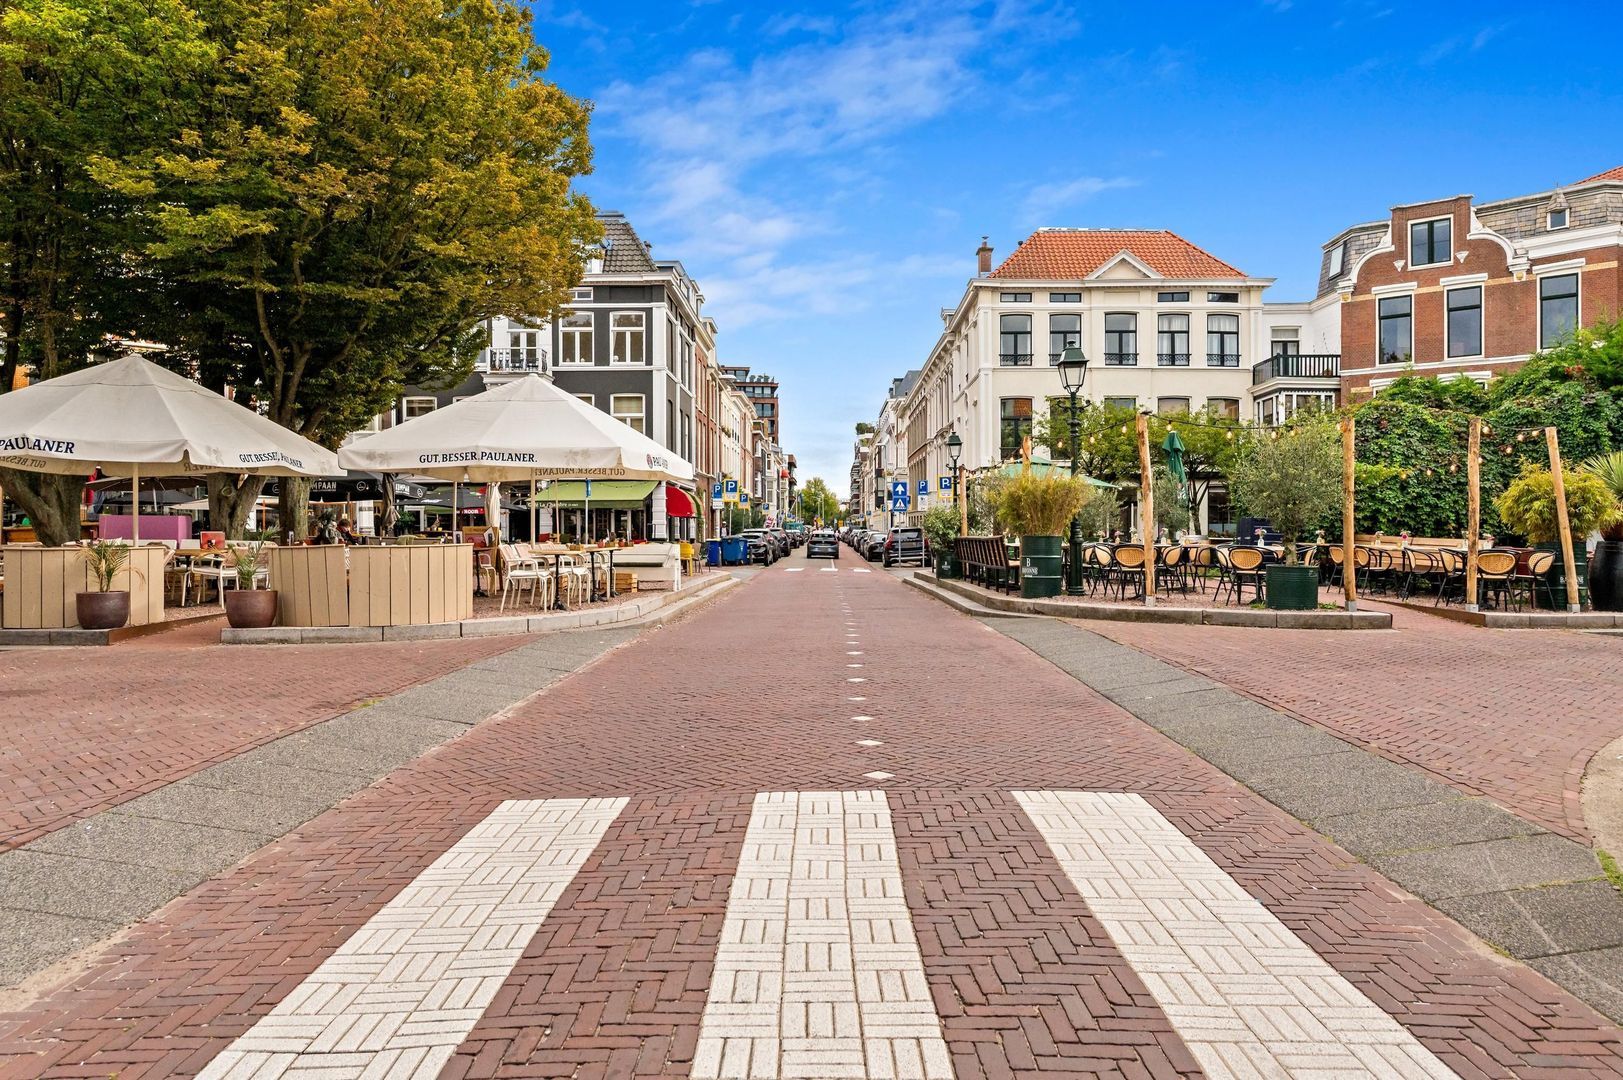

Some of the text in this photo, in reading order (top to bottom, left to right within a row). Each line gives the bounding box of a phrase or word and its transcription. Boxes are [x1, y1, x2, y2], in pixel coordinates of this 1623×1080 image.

[714, 485, 720, 493] P
[728, 481, 735, 491] P
[920, 481, 926, 489] P
[741, 494, 746, 502] P
